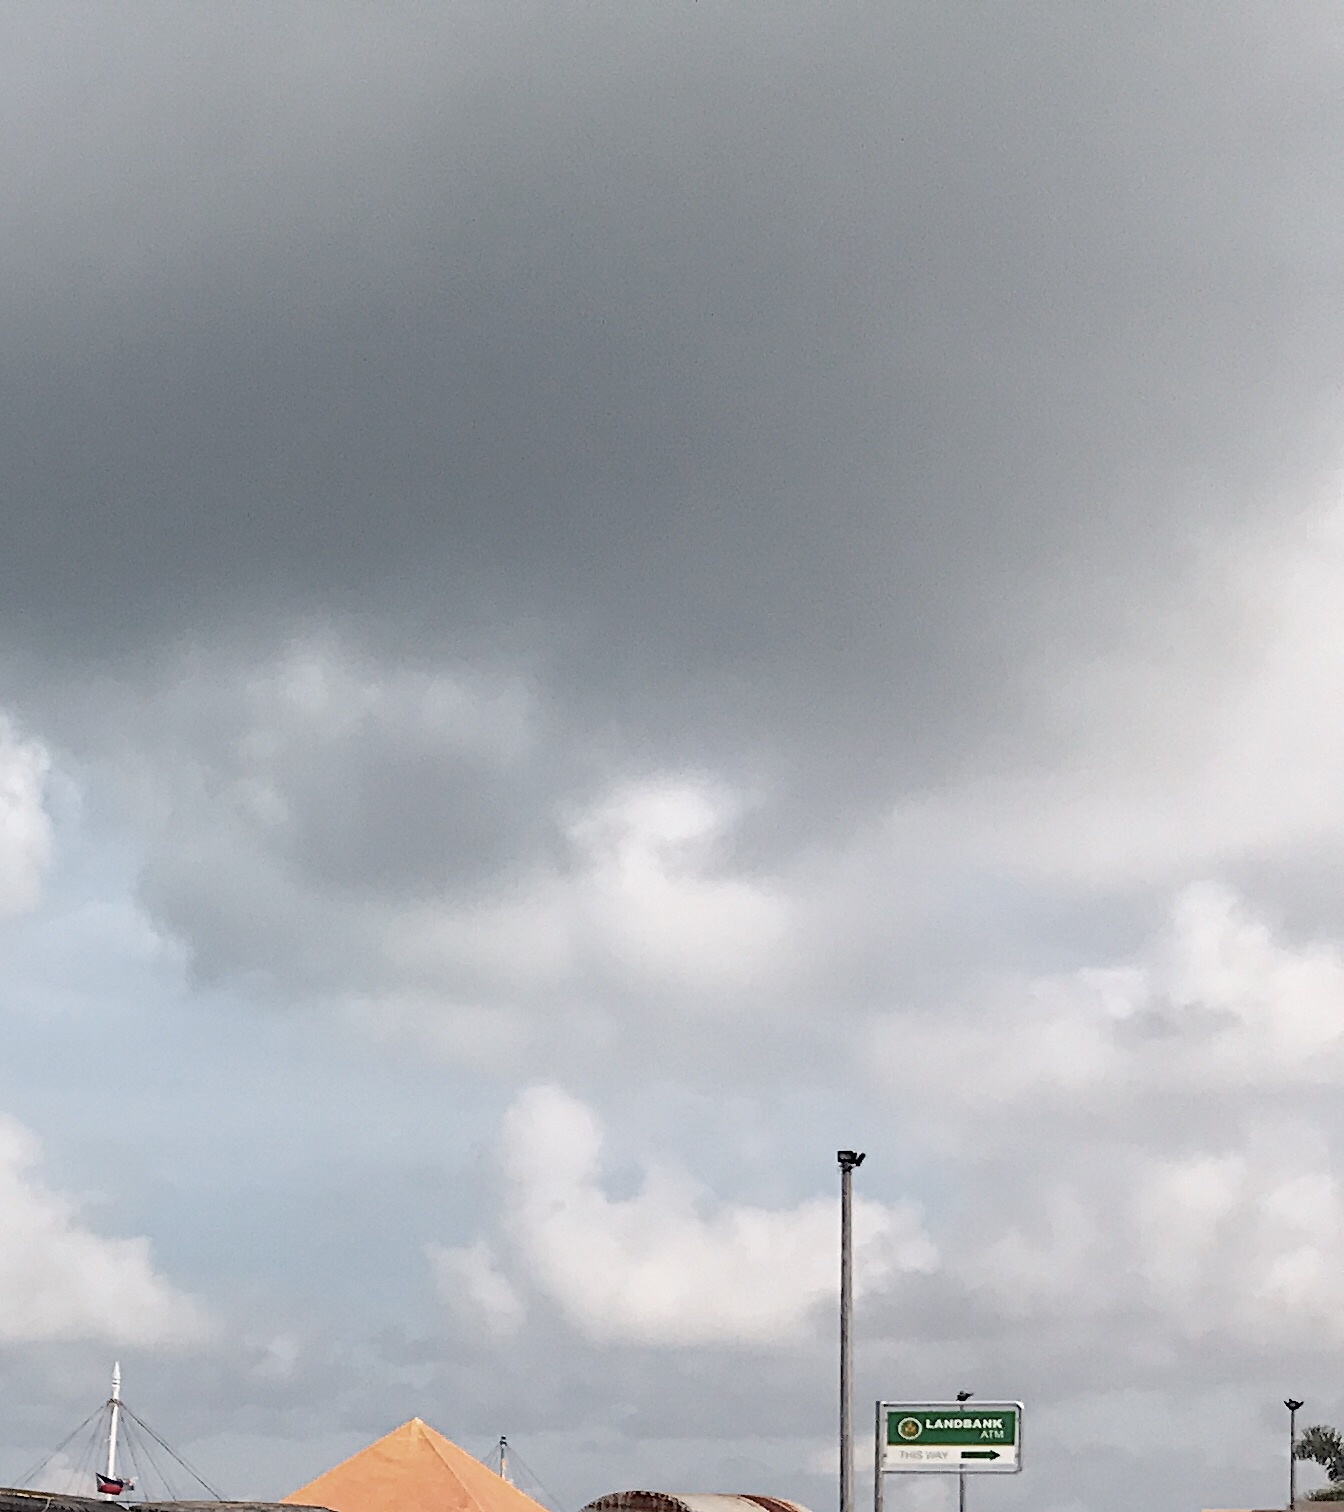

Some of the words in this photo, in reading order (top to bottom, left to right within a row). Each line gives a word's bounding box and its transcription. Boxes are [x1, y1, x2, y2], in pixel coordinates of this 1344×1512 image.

[925, 1418, 1003, 1429] LANDBANK
[980, 1430, 1004, 1439] ATM
[900, 1450, 923, 1460] THIS
[926, 1450, 949, 1460] WAY
